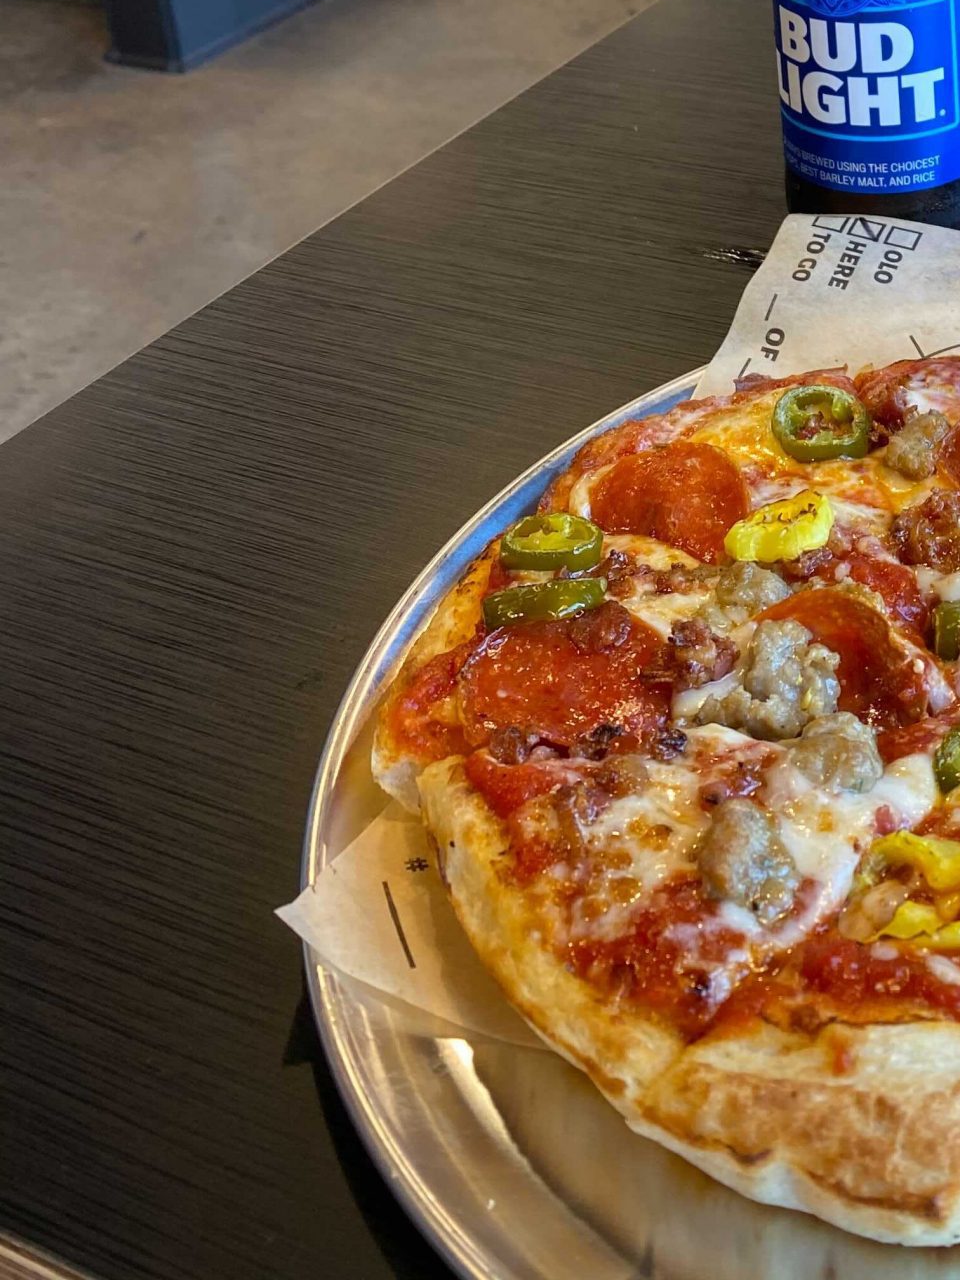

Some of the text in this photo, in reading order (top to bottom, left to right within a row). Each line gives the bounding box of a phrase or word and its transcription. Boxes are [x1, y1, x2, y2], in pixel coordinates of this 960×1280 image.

[778, 4, 914, 74] BUD
[801, 150, 835, 169] BREWED
[836, 159, 866, 173] USING
[868, 163, 888, 173] THE
[890, 155, 940, 173] CHOICEST
[820, 170, 856, 186] BARLEY
[889, 176, 911, 187] AND
[913, 170, 936, 184] RICE
[791, 233, 831, 282] TO GO
[828, 239, 867, 291] HERE
[873, 249, 903, 284] OLO
[760, 327, 785, 362] OF
